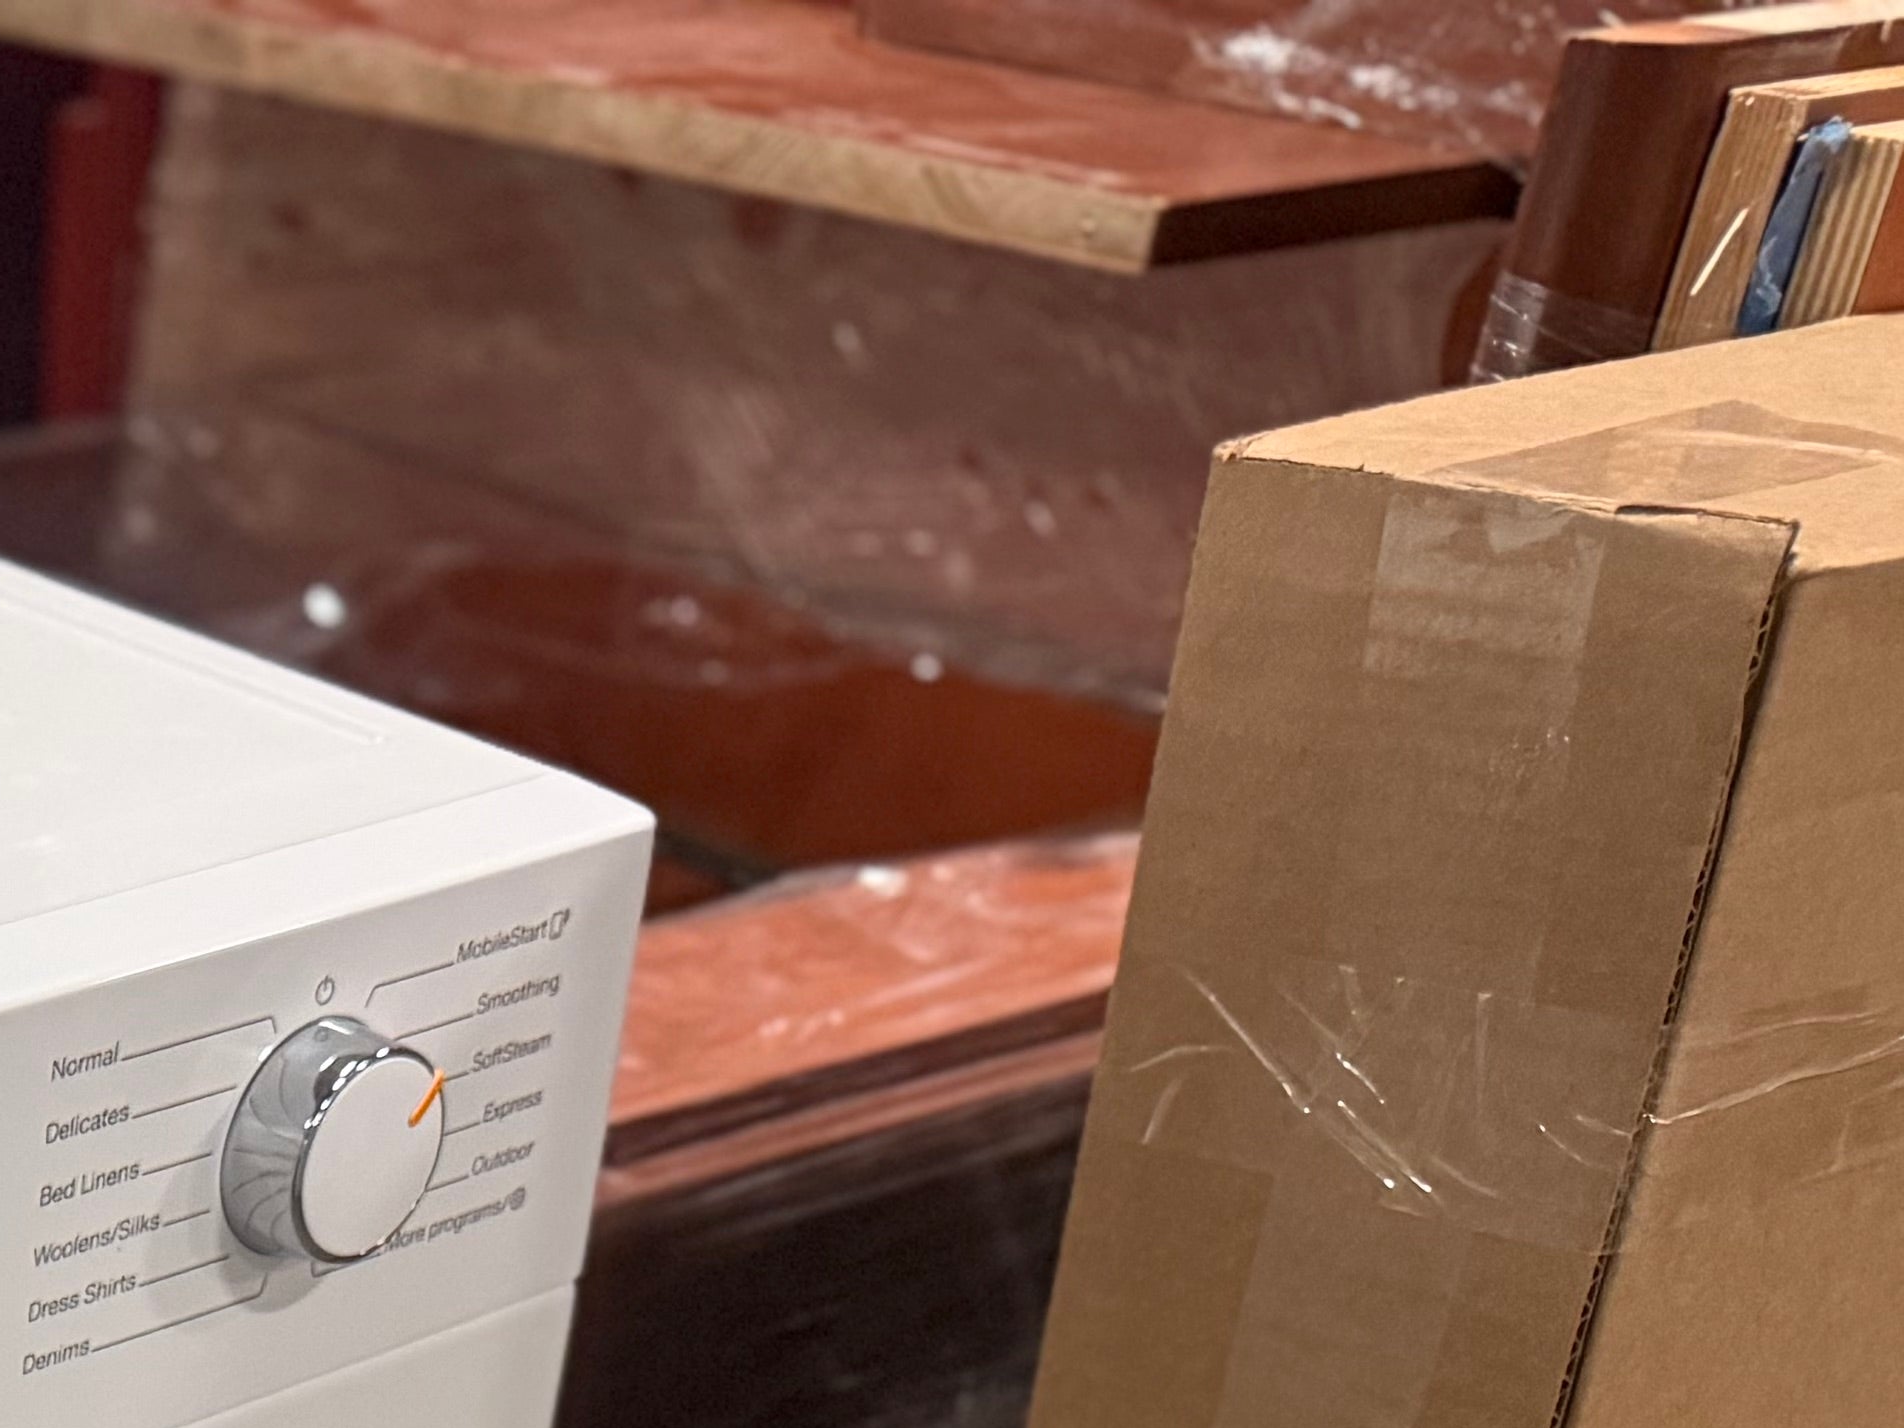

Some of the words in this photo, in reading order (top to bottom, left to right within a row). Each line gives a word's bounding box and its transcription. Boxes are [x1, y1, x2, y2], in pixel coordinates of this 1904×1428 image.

[456, 918, 548, 963] MobileStart
[476, 974, 560, 1014] Smoothing
[50, 1040, 120, 1082] Normal
[471, 1034, 552, 1072] SoftSteam
[45, 1104, 130, 1145] Delicates
[482, 1089, 544, 1123] Express
[471, 1140, 535, 1176] Outdoor
[39, 1178, 76, 1208] Bed
[80, 1162, 141, 1195] Linens
[33, 1213, 161, 1267] Woolens/Silks
[28, 1293, 80, 1323] Dress
[84, 1274, 137, 1305] Shirts
[22, 1338, 90, 1375] Denims
